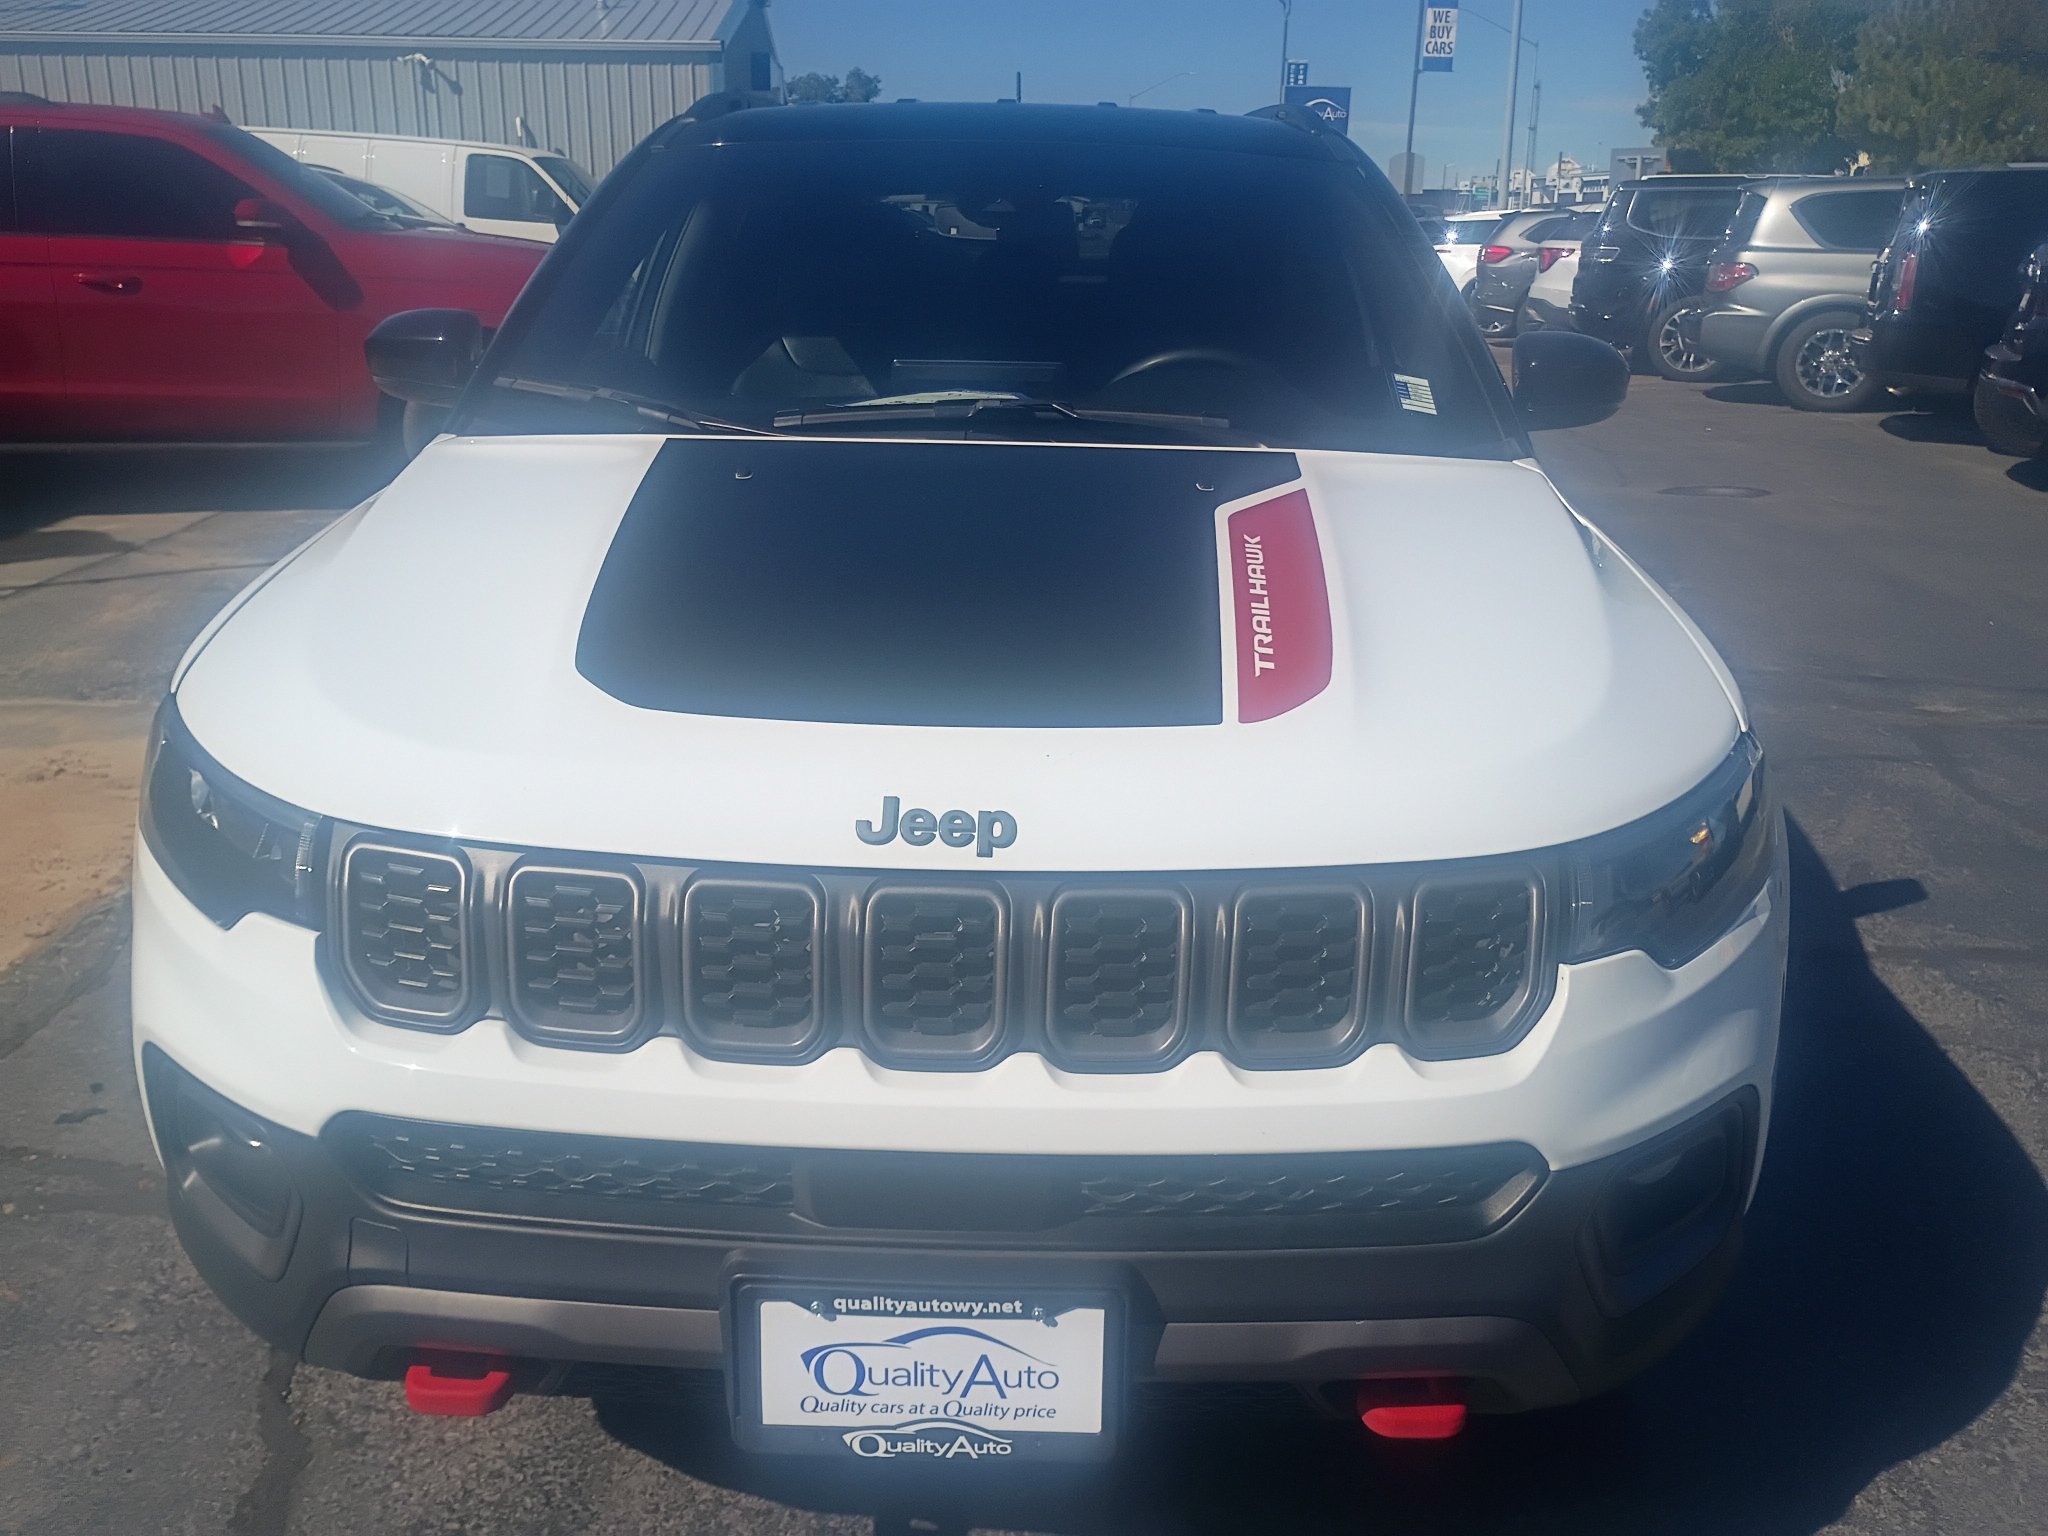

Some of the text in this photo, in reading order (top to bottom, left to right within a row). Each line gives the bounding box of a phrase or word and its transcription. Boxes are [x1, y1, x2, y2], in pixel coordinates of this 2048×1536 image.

[1433, 10, 1451, 23] WE
[1429, 25, 1453, 39] BUY
[1425, 40, 1454, 55] CARS
[1243, 534, 1275, 677] TRAILHAWK
[855, 796, 1018, 858] Jeep
[833, 1296, 1022, 1316] qualityautowy.net
[800, 1395, 1057, 1420] Quality cars at a Quality price
